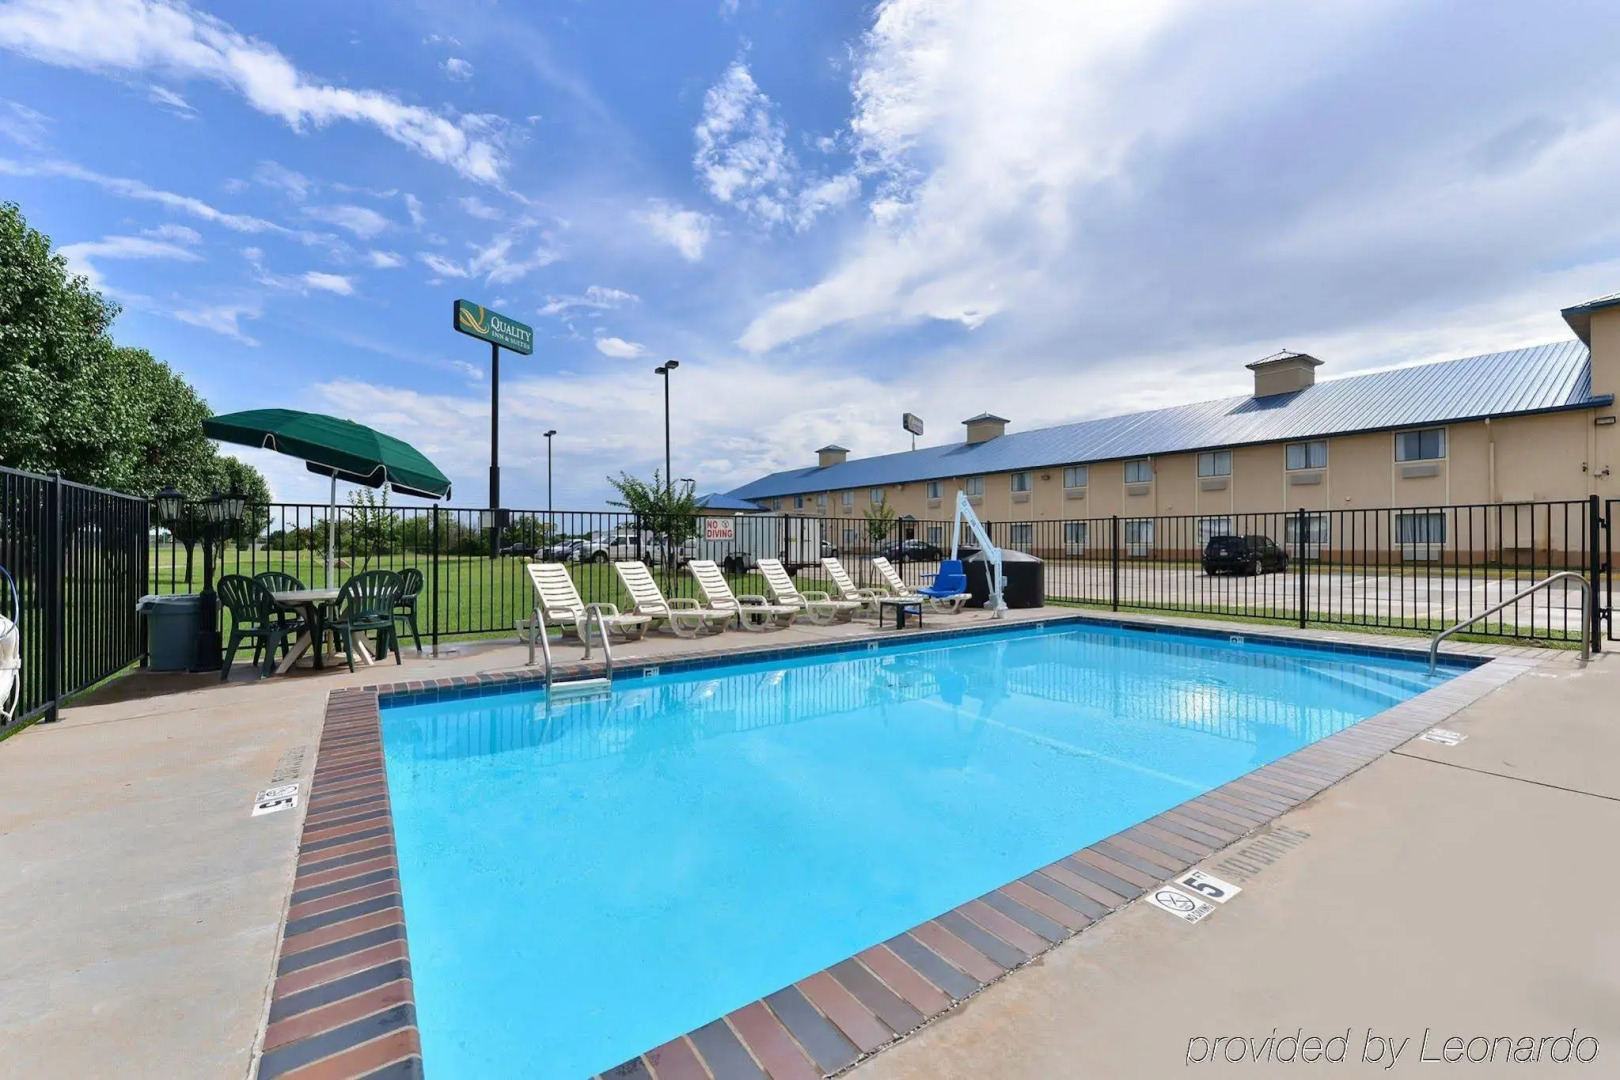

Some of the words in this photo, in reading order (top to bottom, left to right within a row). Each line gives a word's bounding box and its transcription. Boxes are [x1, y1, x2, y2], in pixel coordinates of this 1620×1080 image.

[491, 316, 532, 342] QUALITY
[491, 331, 504, 341] INN
[707, 520, 718, 529] NO
[706, 529, 733, 538] DIVING
[1183, 877, 1225, 897] 5
